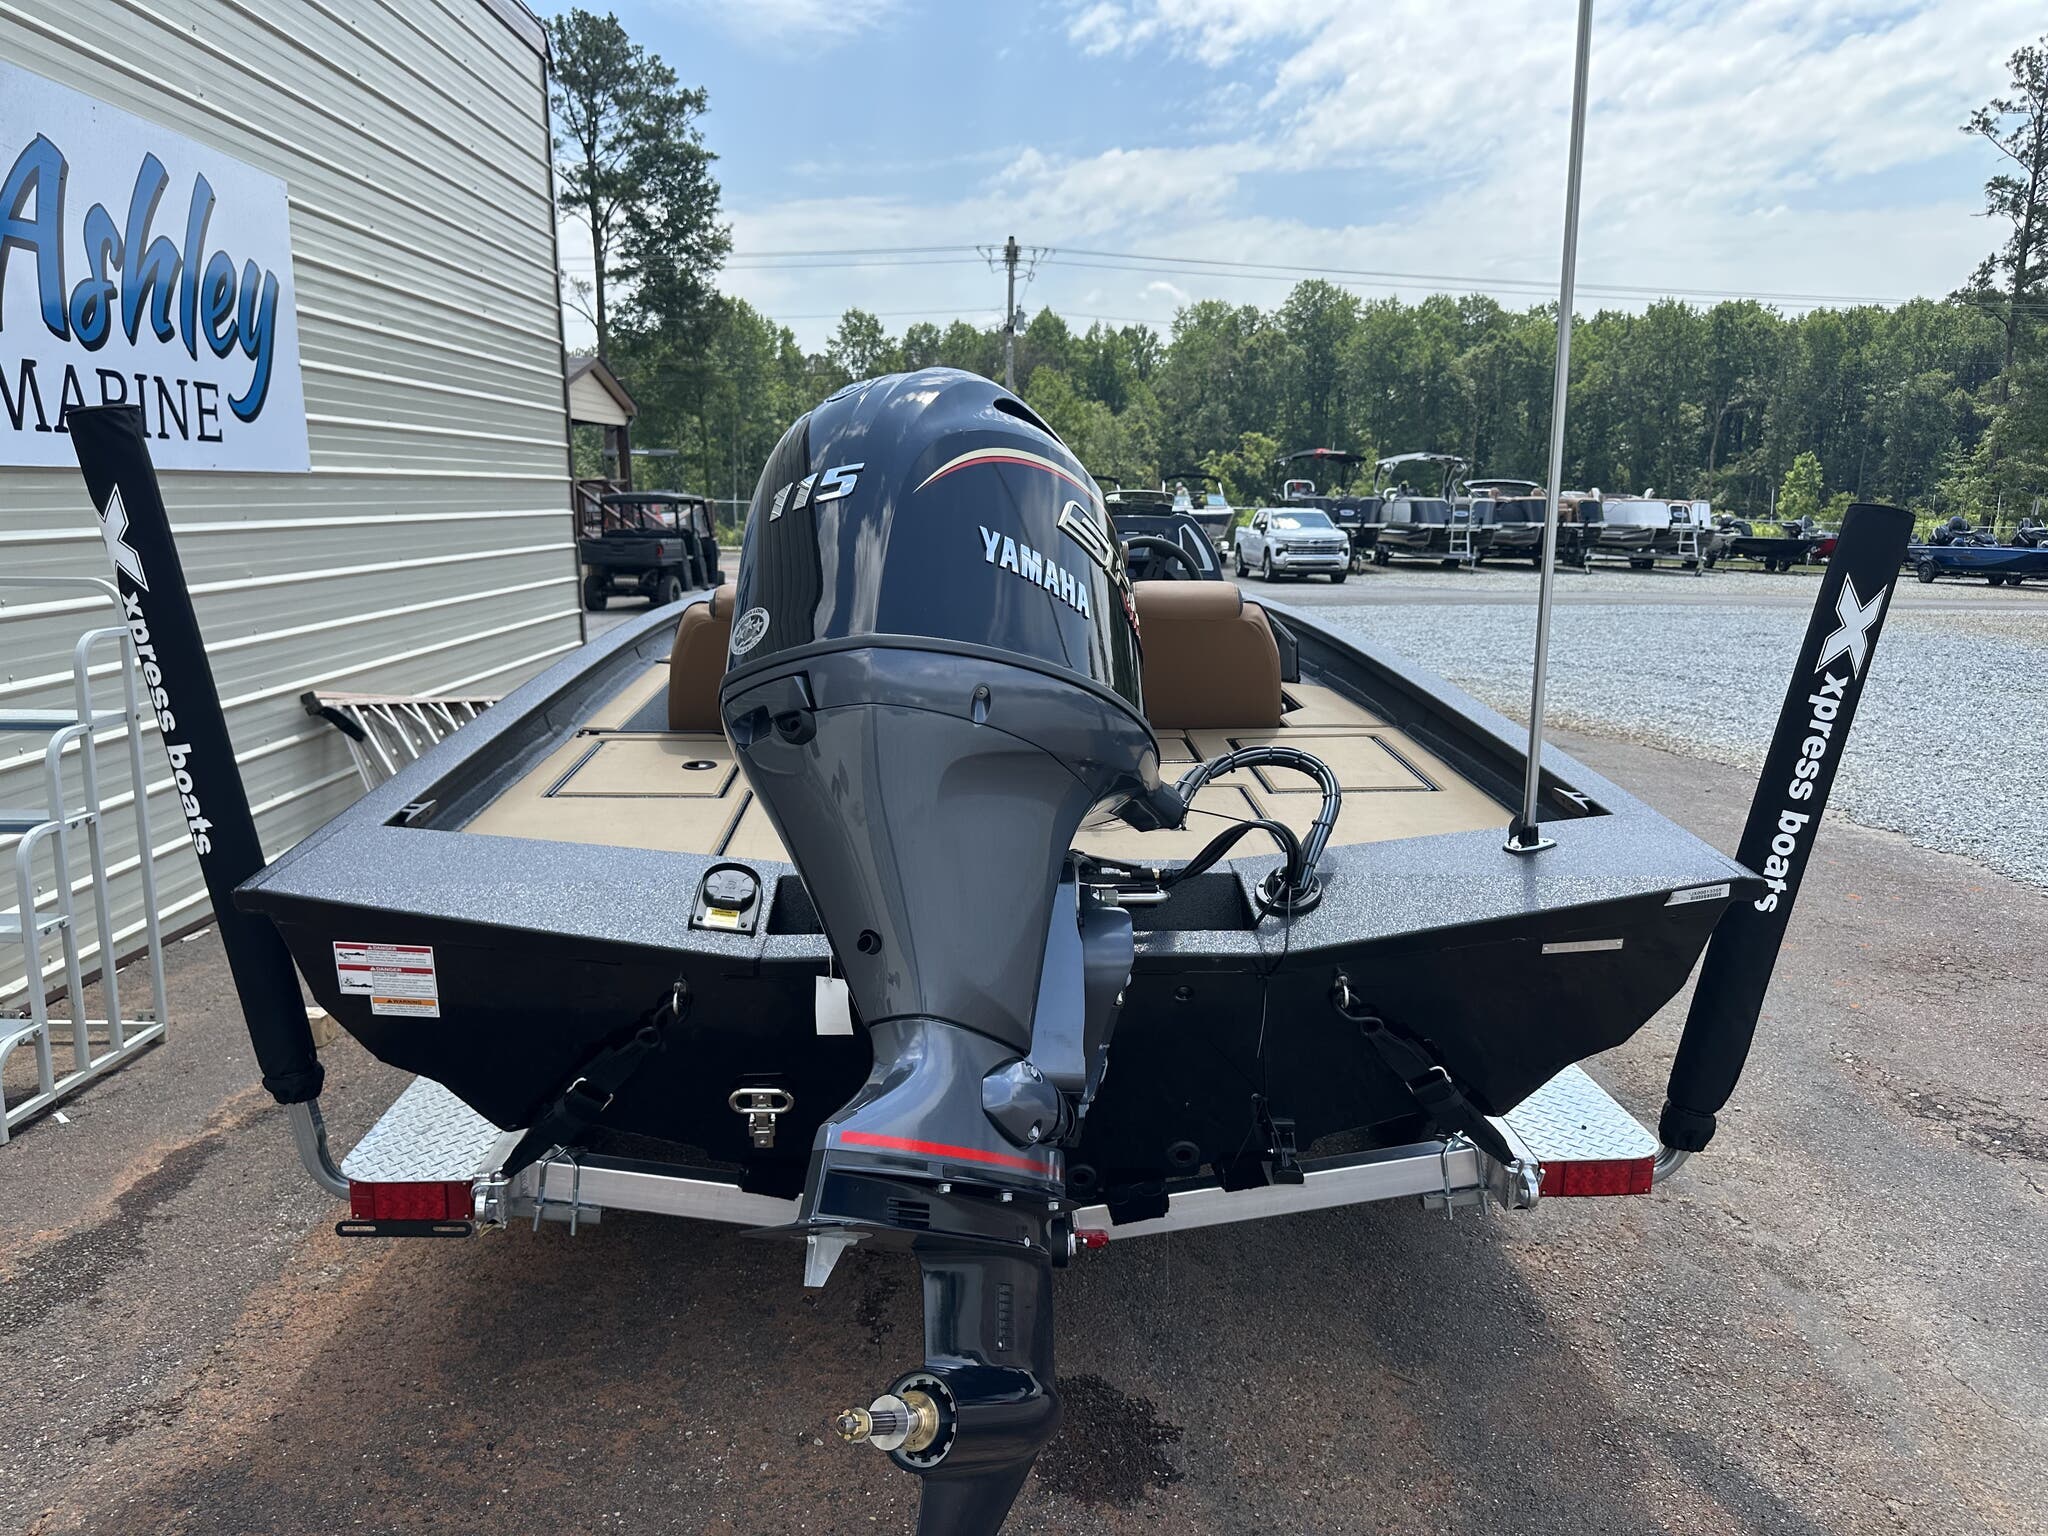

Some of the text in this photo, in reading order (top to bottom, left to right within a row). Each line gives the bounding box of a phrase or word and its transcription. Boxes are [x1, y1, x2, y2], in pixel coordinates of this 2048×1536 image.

[0, 132, 280, 423] Ashley
[768, 462, 865, 522] 115
[979, 525, 1090, 619] YAMAHA
[121, 590, 176, 733] xpress
[167, 743, 213, 855] boats
[1789, 671, 1849, 802] xpress
[1754, 809, 1810, 913] boats
